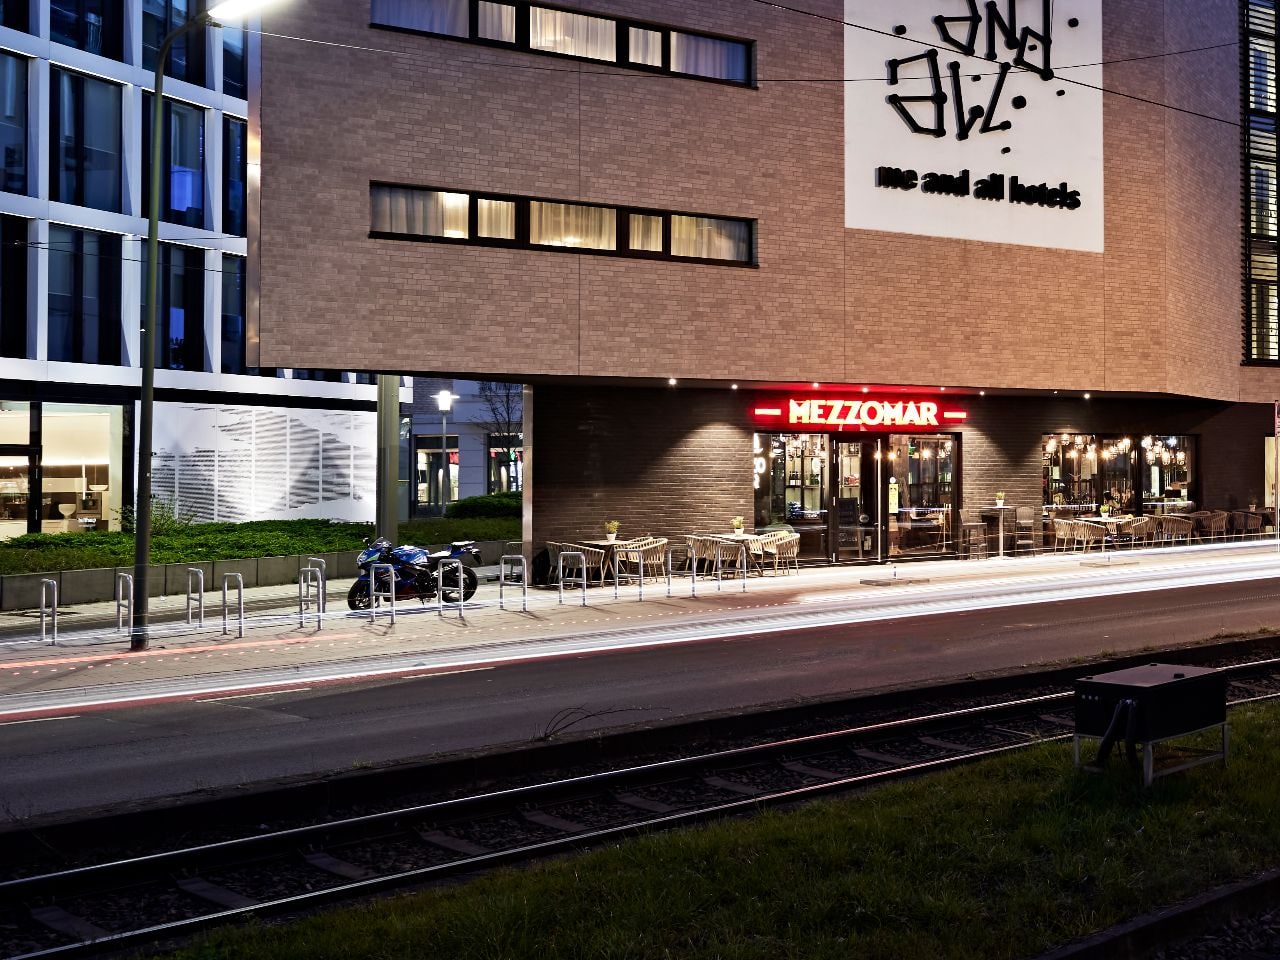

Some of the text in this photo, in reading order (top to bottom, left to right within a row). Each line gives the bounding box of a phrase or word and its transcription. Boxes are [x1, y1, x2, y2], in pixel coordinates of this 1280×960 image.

[875, 166, 1081, 210] me and all hotels
[789, 399, 939, 426] MEZZOMAR
